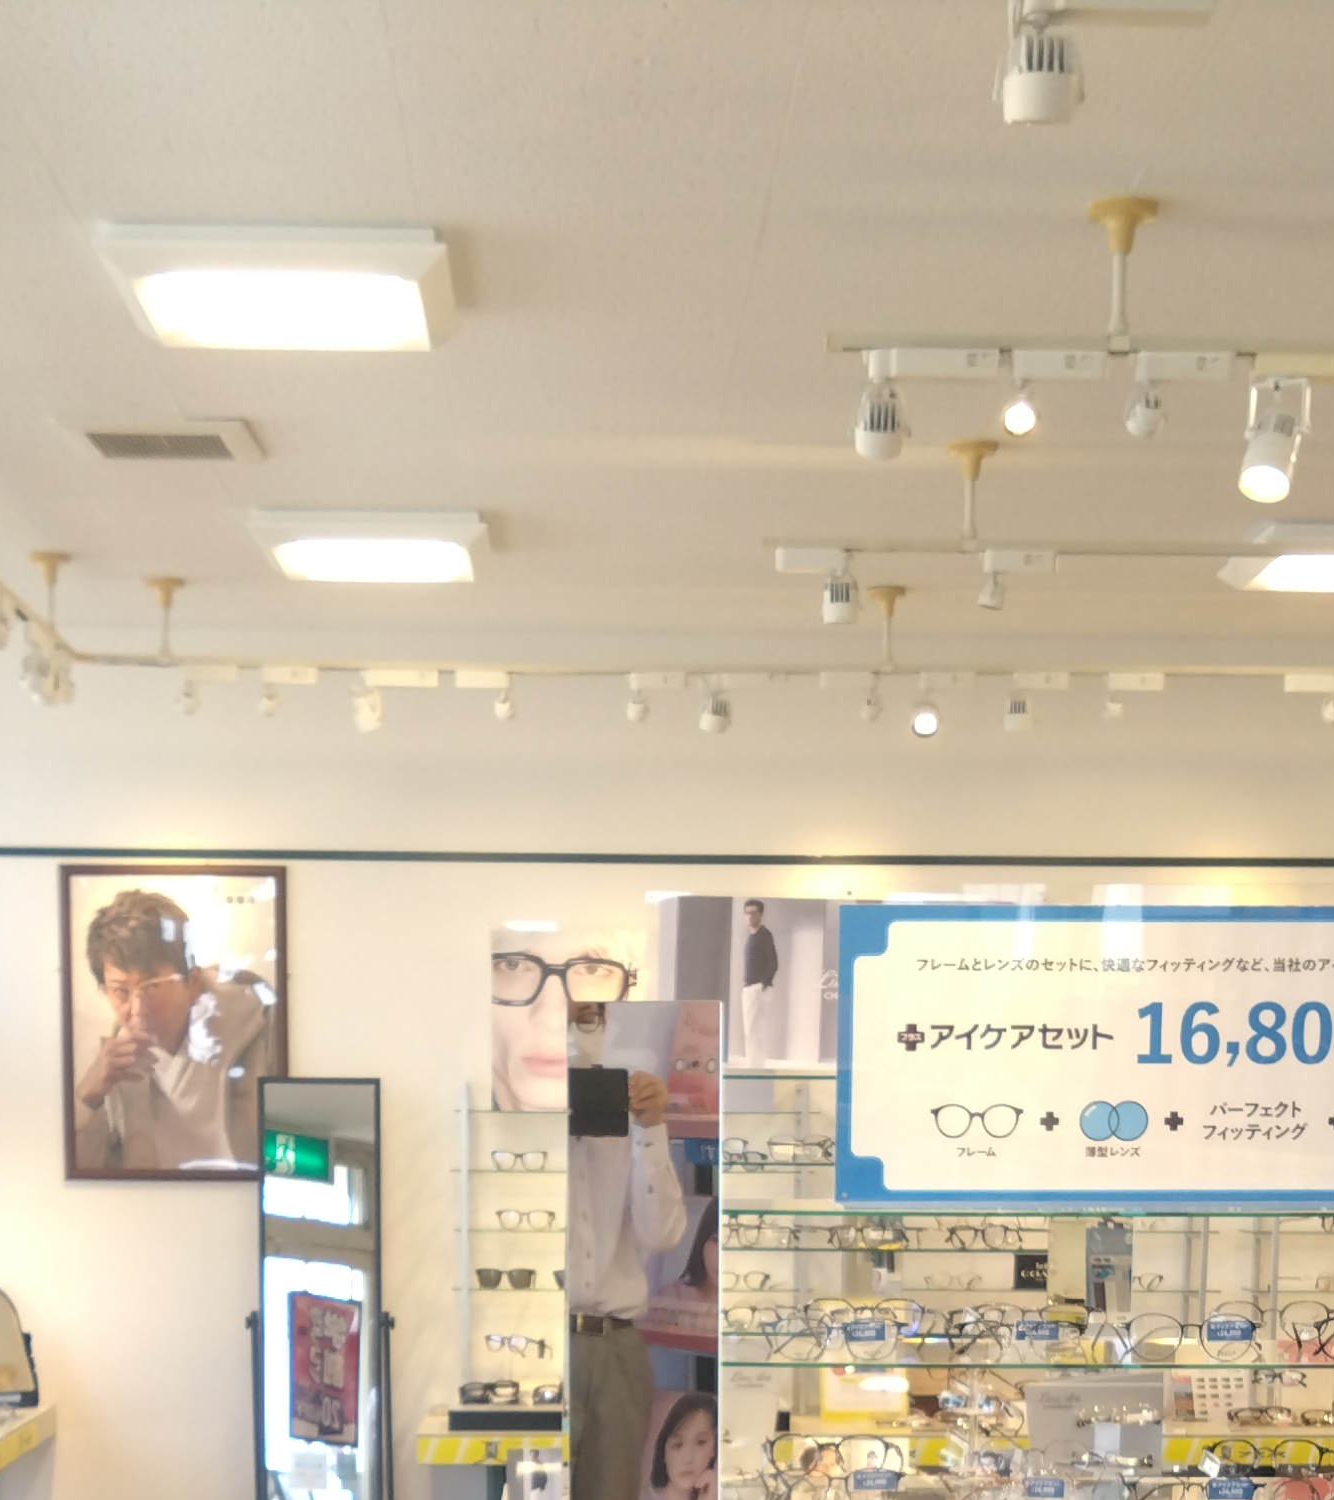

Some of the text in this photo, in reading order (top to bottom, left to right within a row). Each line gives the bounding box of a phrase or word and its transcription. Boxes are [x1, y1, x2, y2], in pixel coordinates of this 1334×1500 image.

[929, 1023, 1114, 1051] アイケアセット
[1210, 1101, 1302, 1117] パーフェクト
[1202, 1122, 1308, 1141] フィッティング
[956, 1146, 997, 1157] フレーム
[1085, 1146, 1141, 1158] 薄型レンズ
